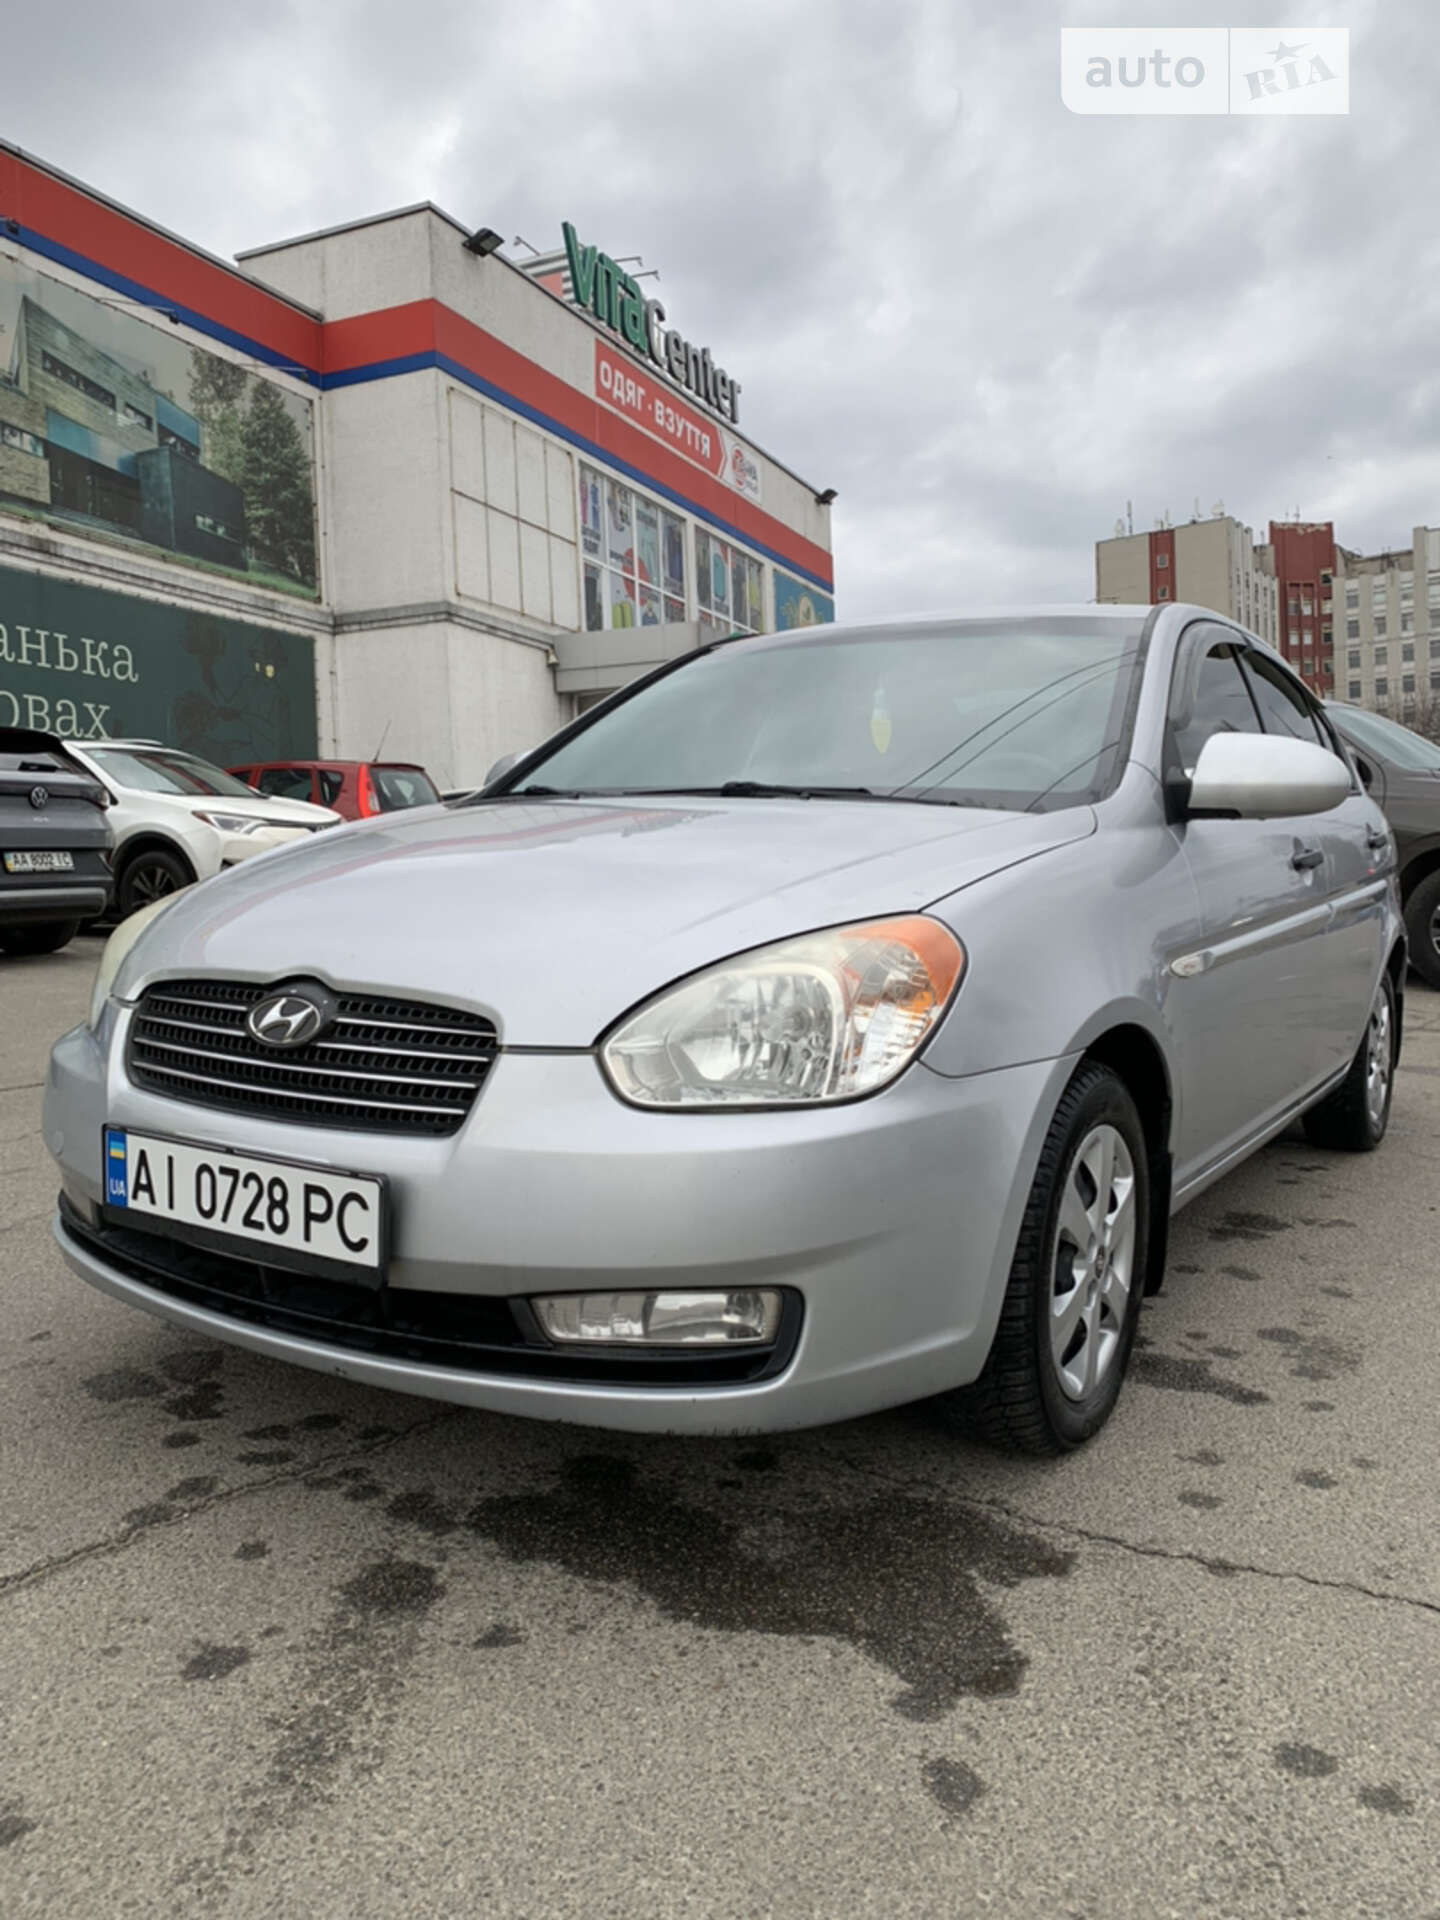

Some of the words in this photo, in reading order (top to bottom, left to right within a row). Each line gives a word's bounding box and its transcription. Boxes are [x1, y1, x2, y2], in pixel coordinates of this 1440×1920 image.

[600, 360, 646, 411] ОДЯГ
[654, 399, 711, 459] ВЗУТТЯ
[109, 1178, 127, 1197] UA
[131, 1148, 175, 1210] AI
[195, 1163, 290, 1235] 0728
[303, 1183, 370, 1254] PC
